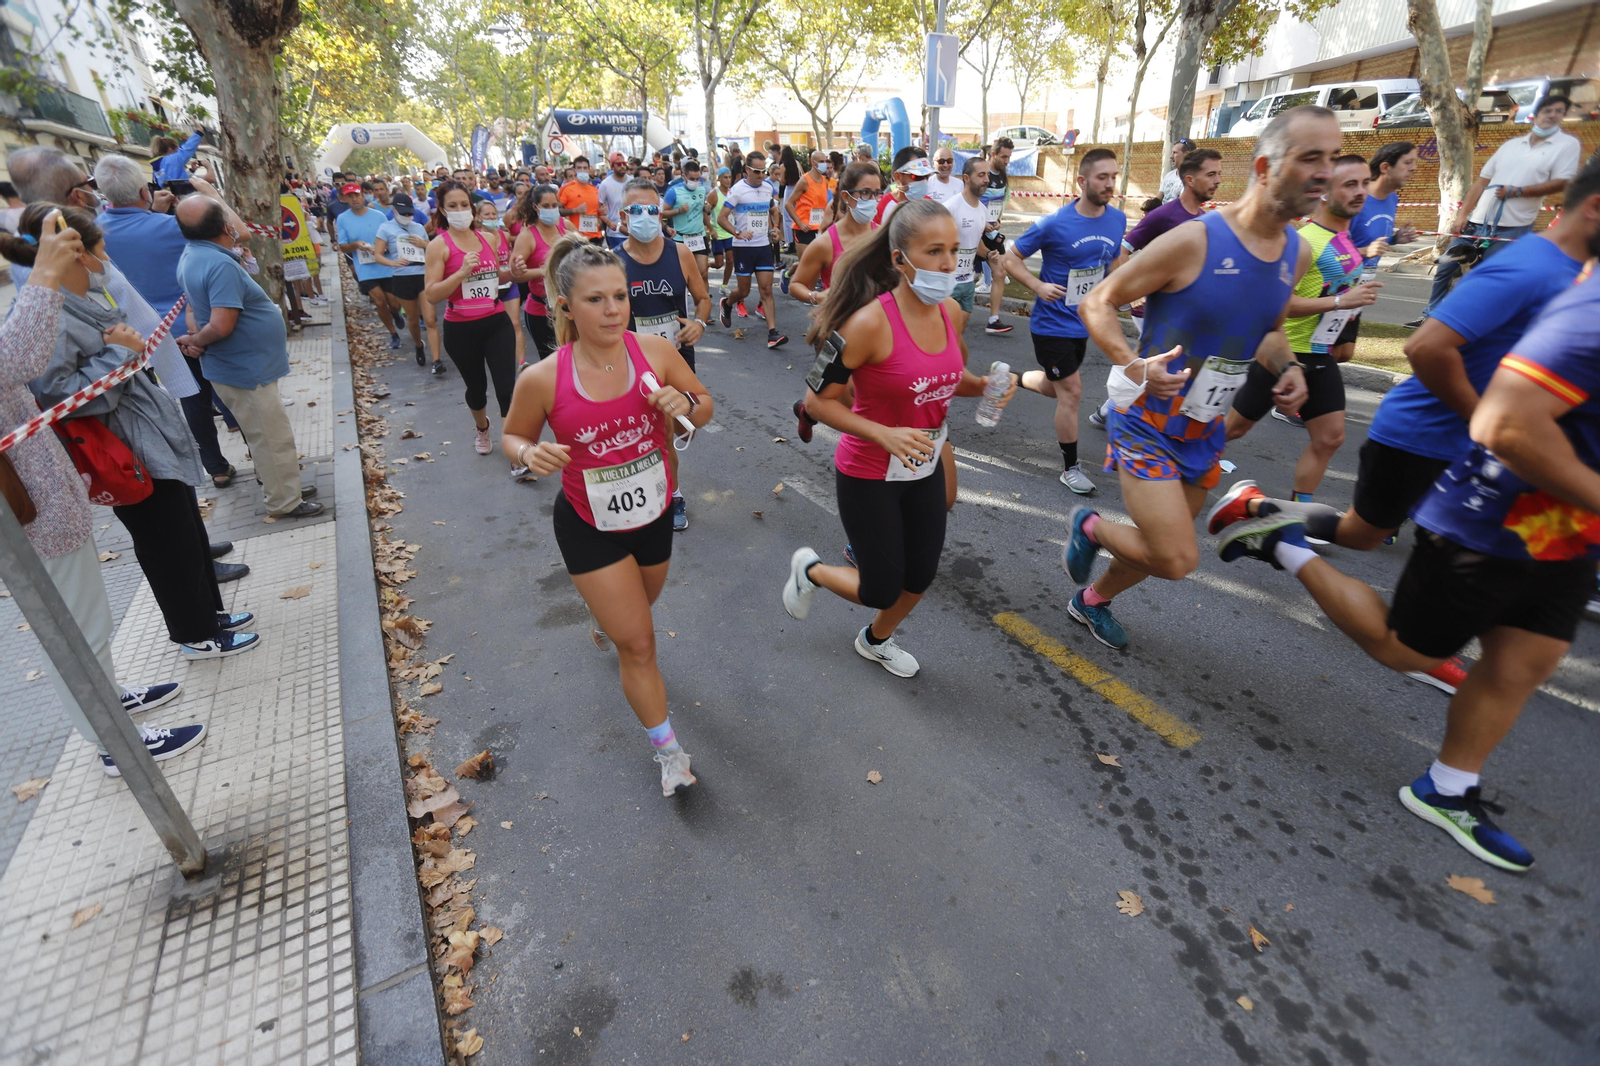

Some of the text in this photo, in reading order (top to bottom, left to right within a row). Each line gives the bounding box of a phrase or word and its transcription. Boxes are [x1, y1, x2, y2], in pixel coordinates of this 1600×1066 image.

[589, 115, 638, 124] HYUNDAI
[291, 245, 310, 254] ZONA
[402, 247, 416, 256] 199
[470, 286, 491, 299] 382
[630, 279, 674, 297] FILA
[600, 413, 657, 432] HYROX
[601, 466, 630, 481] VUELTA
[630, 464, 637, 475] A
[636, 453, 659, 472] HUELVA
[607, 486, 646, 514] 403
